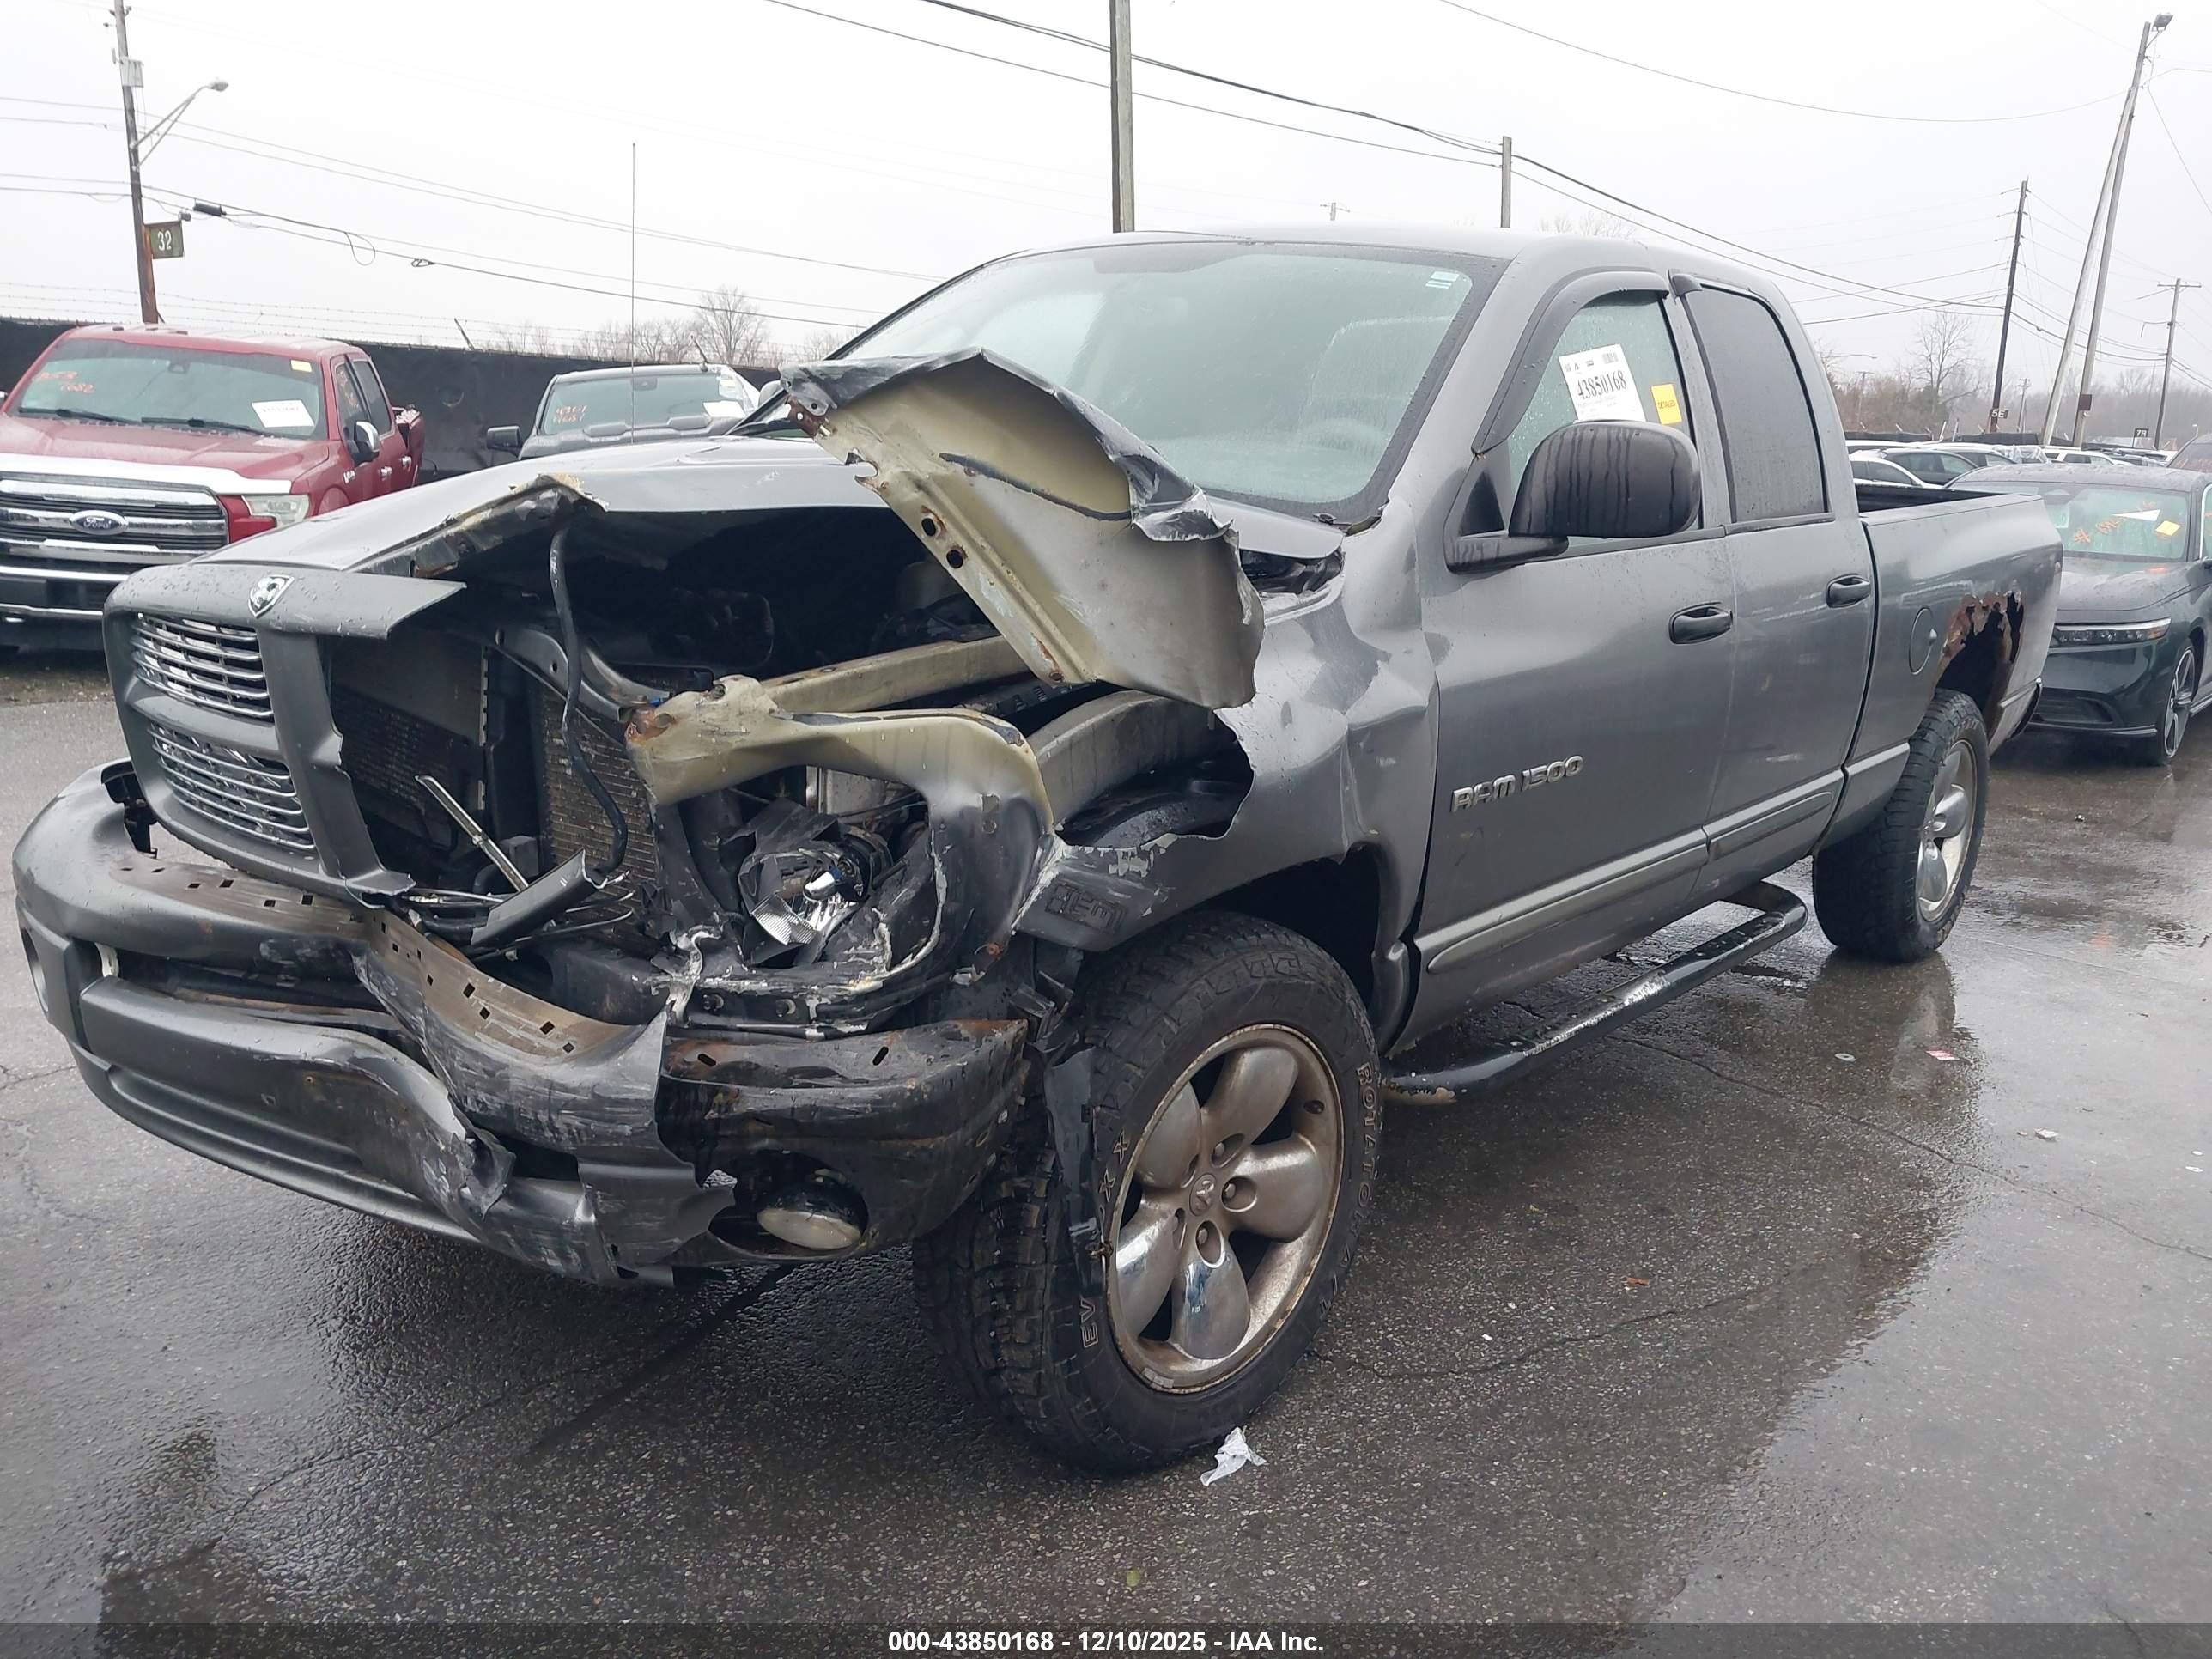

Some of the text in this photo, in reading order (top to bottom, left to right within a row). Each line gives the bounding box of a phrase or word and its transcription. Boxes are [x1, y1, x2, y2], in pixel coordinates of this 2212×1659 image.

[158, 230, 172, 251] 32
[1578, 370, 1626, 400] 43850168
[1450, 755, 1583, 812] RAM 1500
